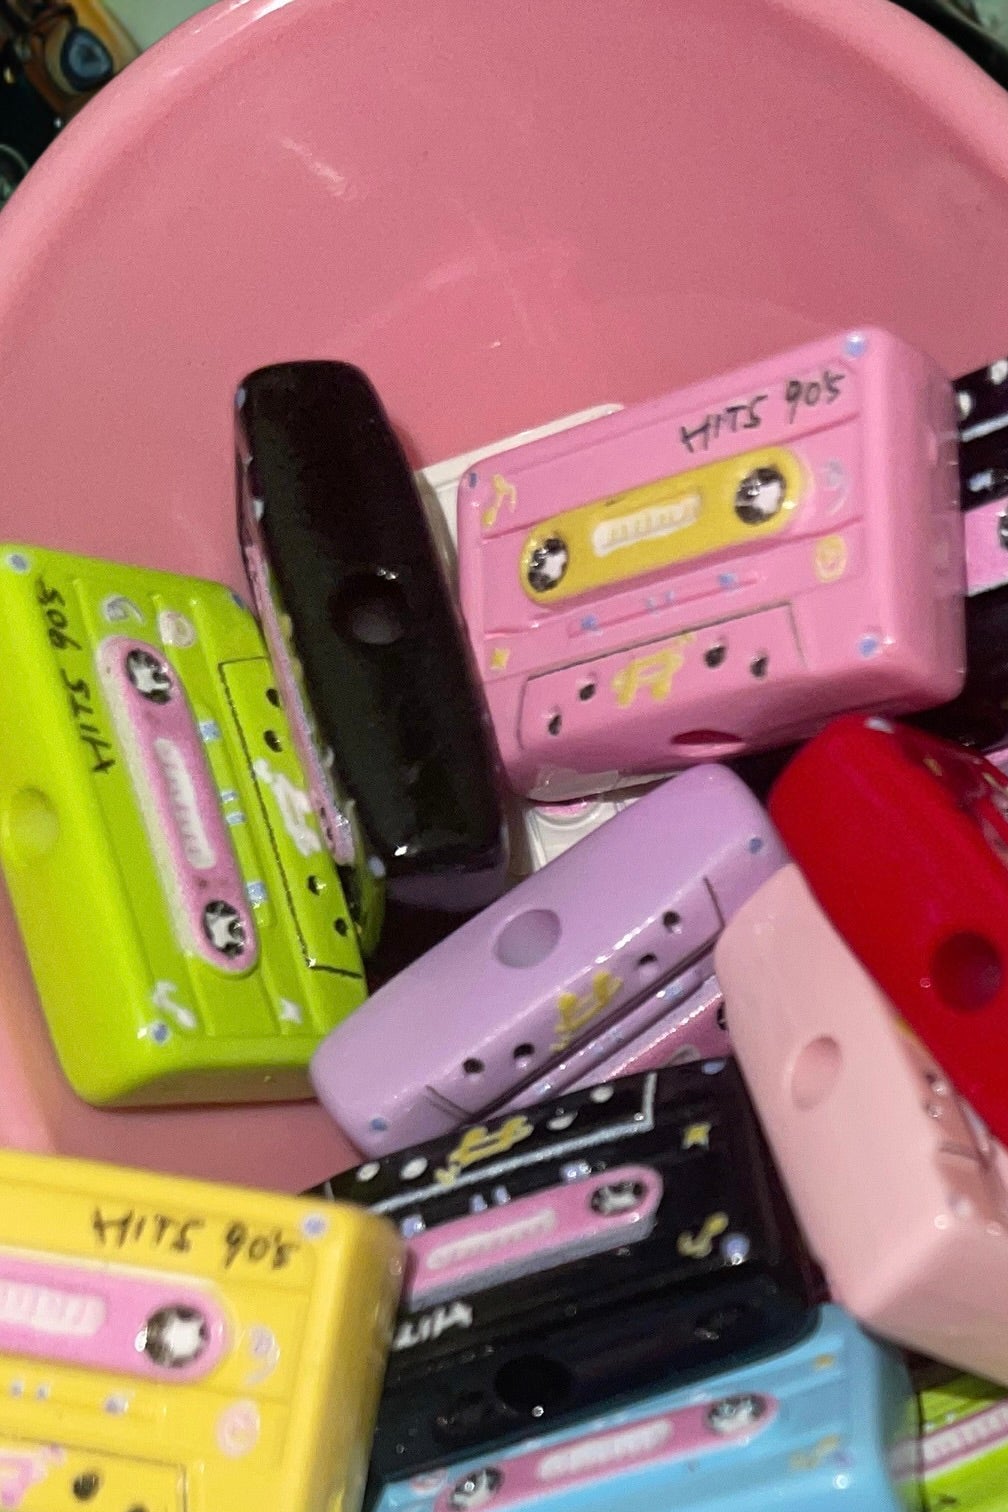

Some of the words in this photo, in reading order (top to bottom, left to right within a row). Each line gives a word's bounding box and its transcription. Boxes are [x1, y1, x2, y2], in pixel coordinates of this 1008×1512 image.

[681, 394, 768, 453] HITS
[62, 667, 116, 775] HITS
[92, 1206, 205, 1254] HITS
